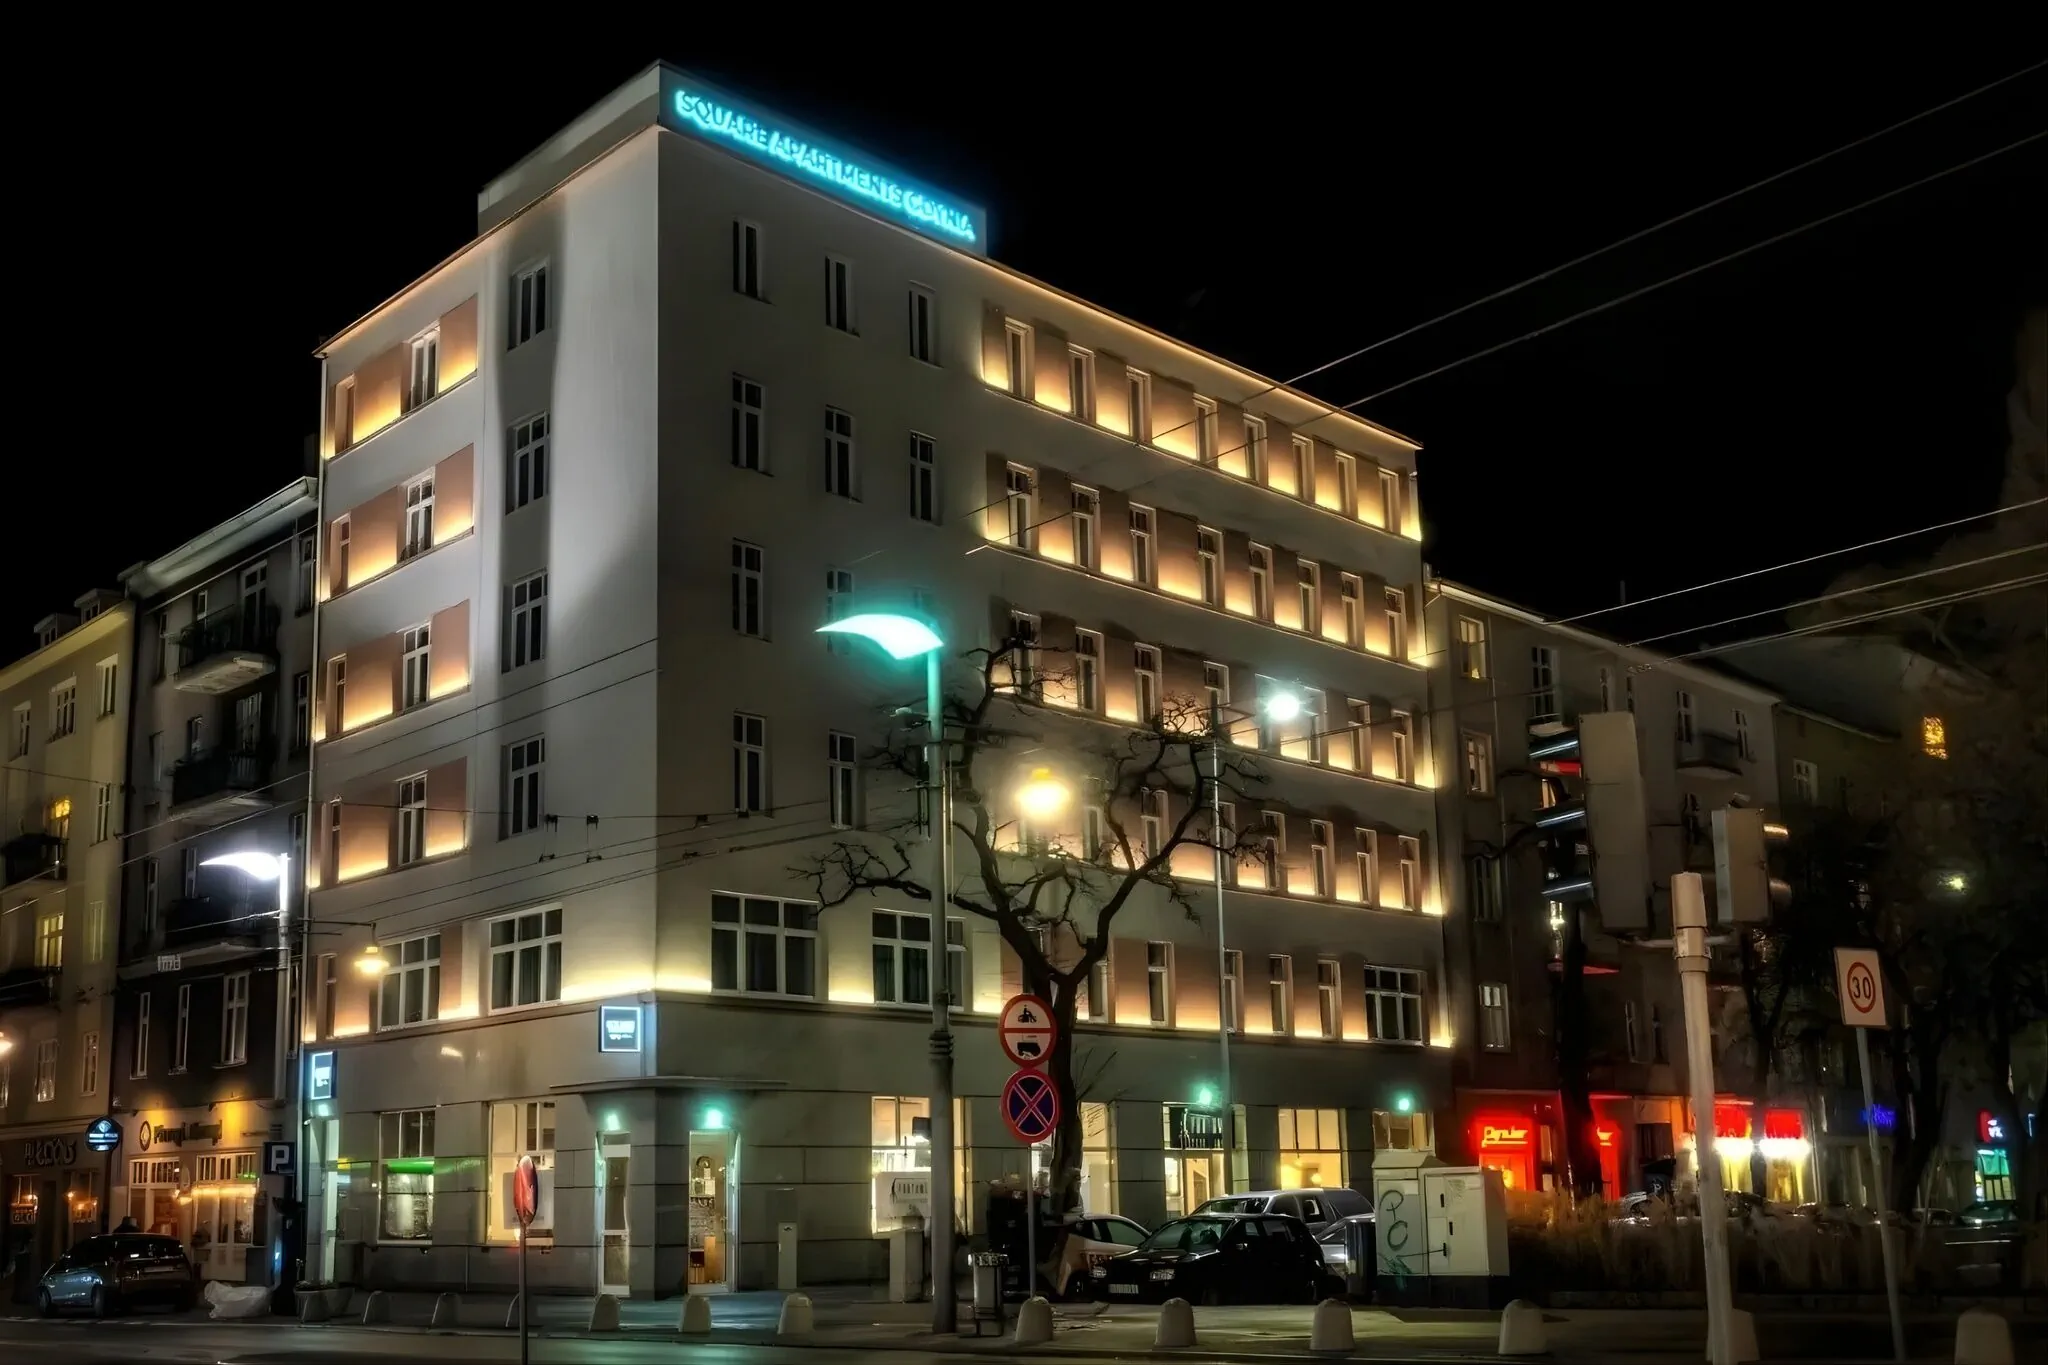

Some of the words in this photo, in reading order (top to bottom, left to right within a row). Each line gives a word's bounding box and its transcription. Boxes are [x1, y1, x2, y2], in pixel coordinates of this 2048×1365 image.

[676, 89, 768, 150] SQUARE
[768, 131, 902, 208] APARTMENTS
[1852, 976, 1871, 999] 30
[271, 1145, 290, 1171] P
